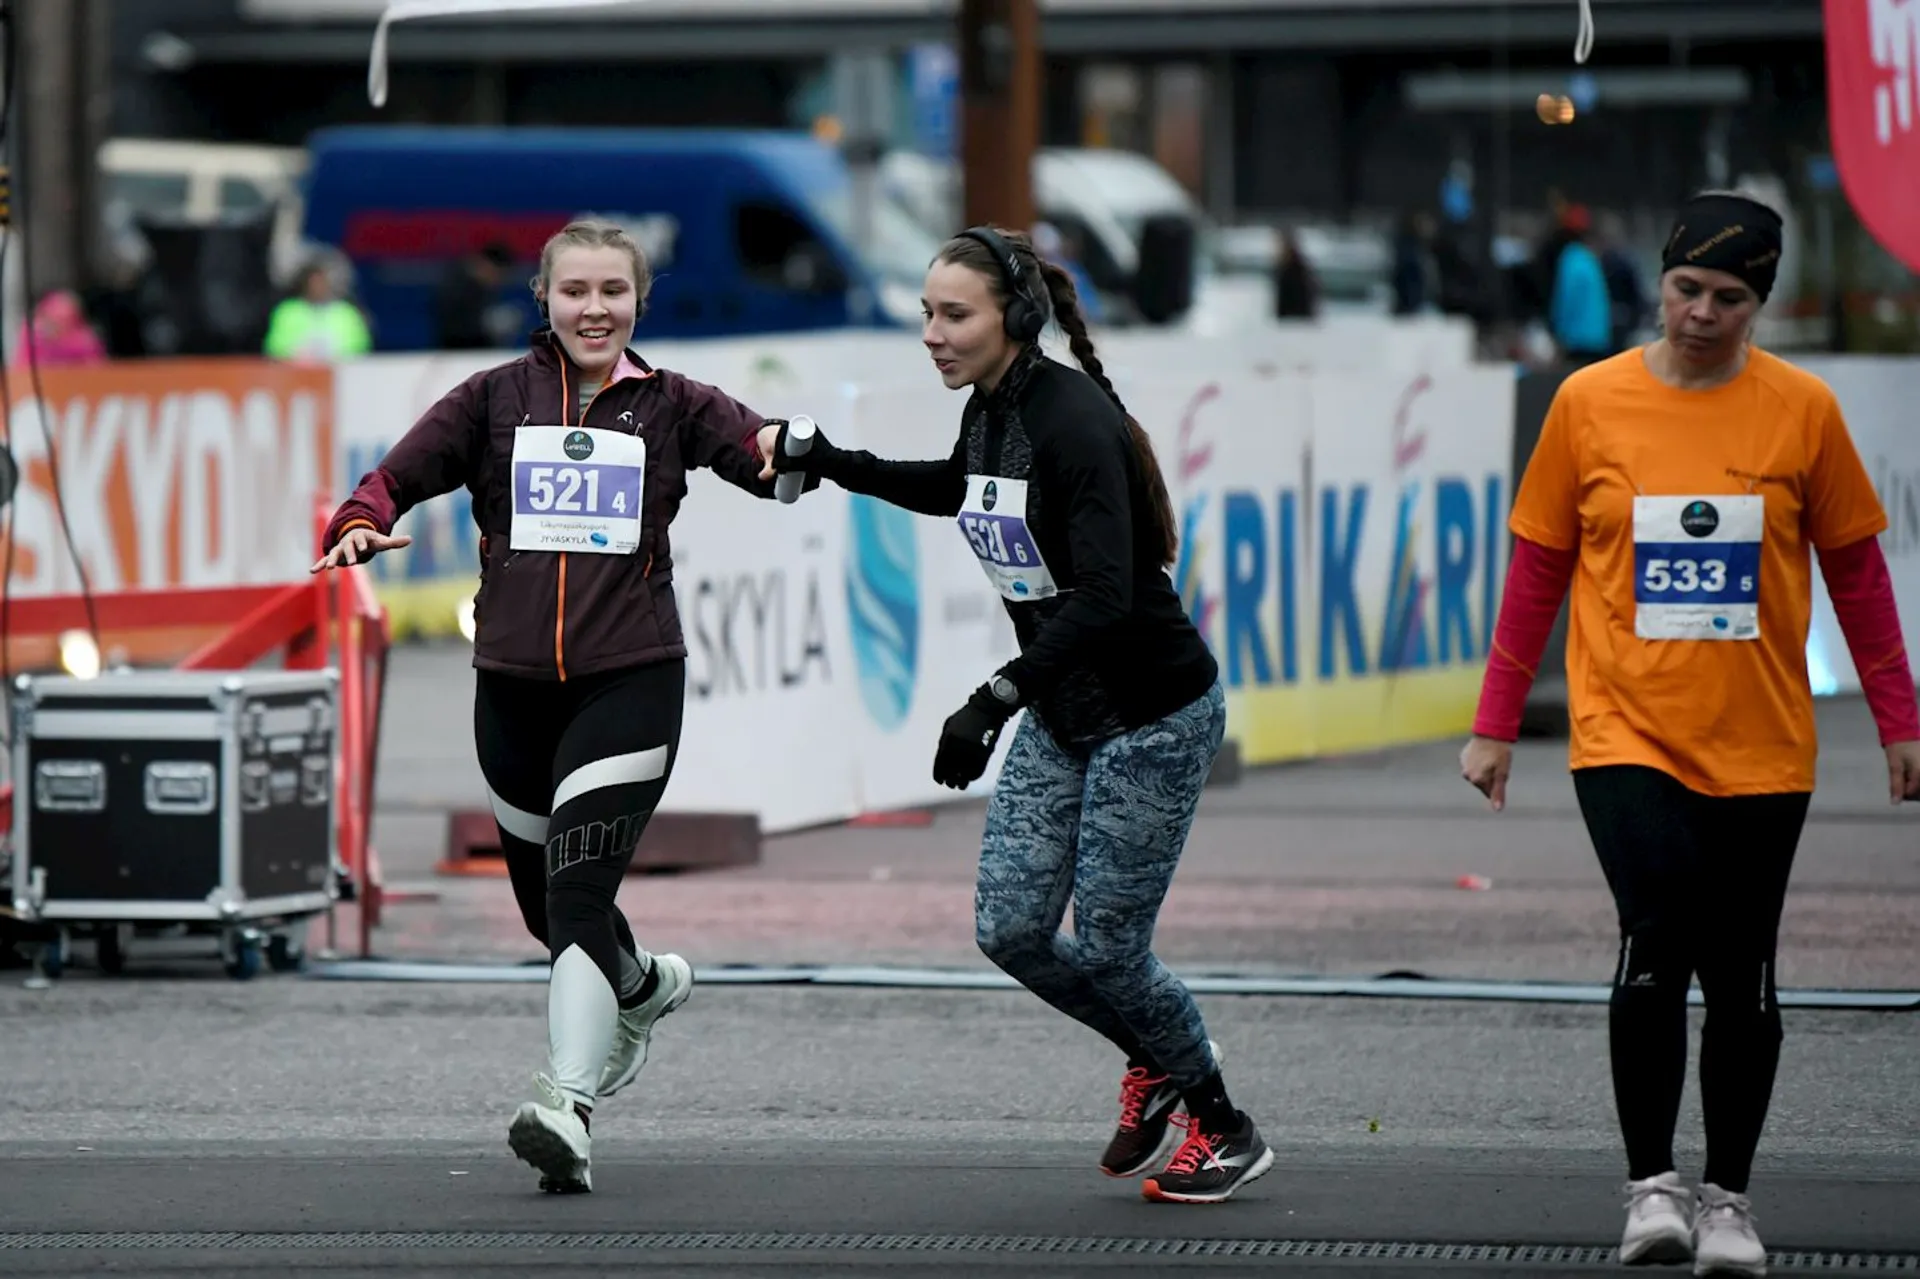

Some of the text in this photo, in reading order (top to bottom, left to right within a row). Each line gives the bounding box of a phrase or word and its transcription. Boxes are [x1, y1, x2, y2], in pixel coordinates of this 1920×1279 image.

[529, 467, 627, 513] 521 4
[964, 517, 1028, 563] 521 6
[1644, 559, 1753, 592] 533 5
